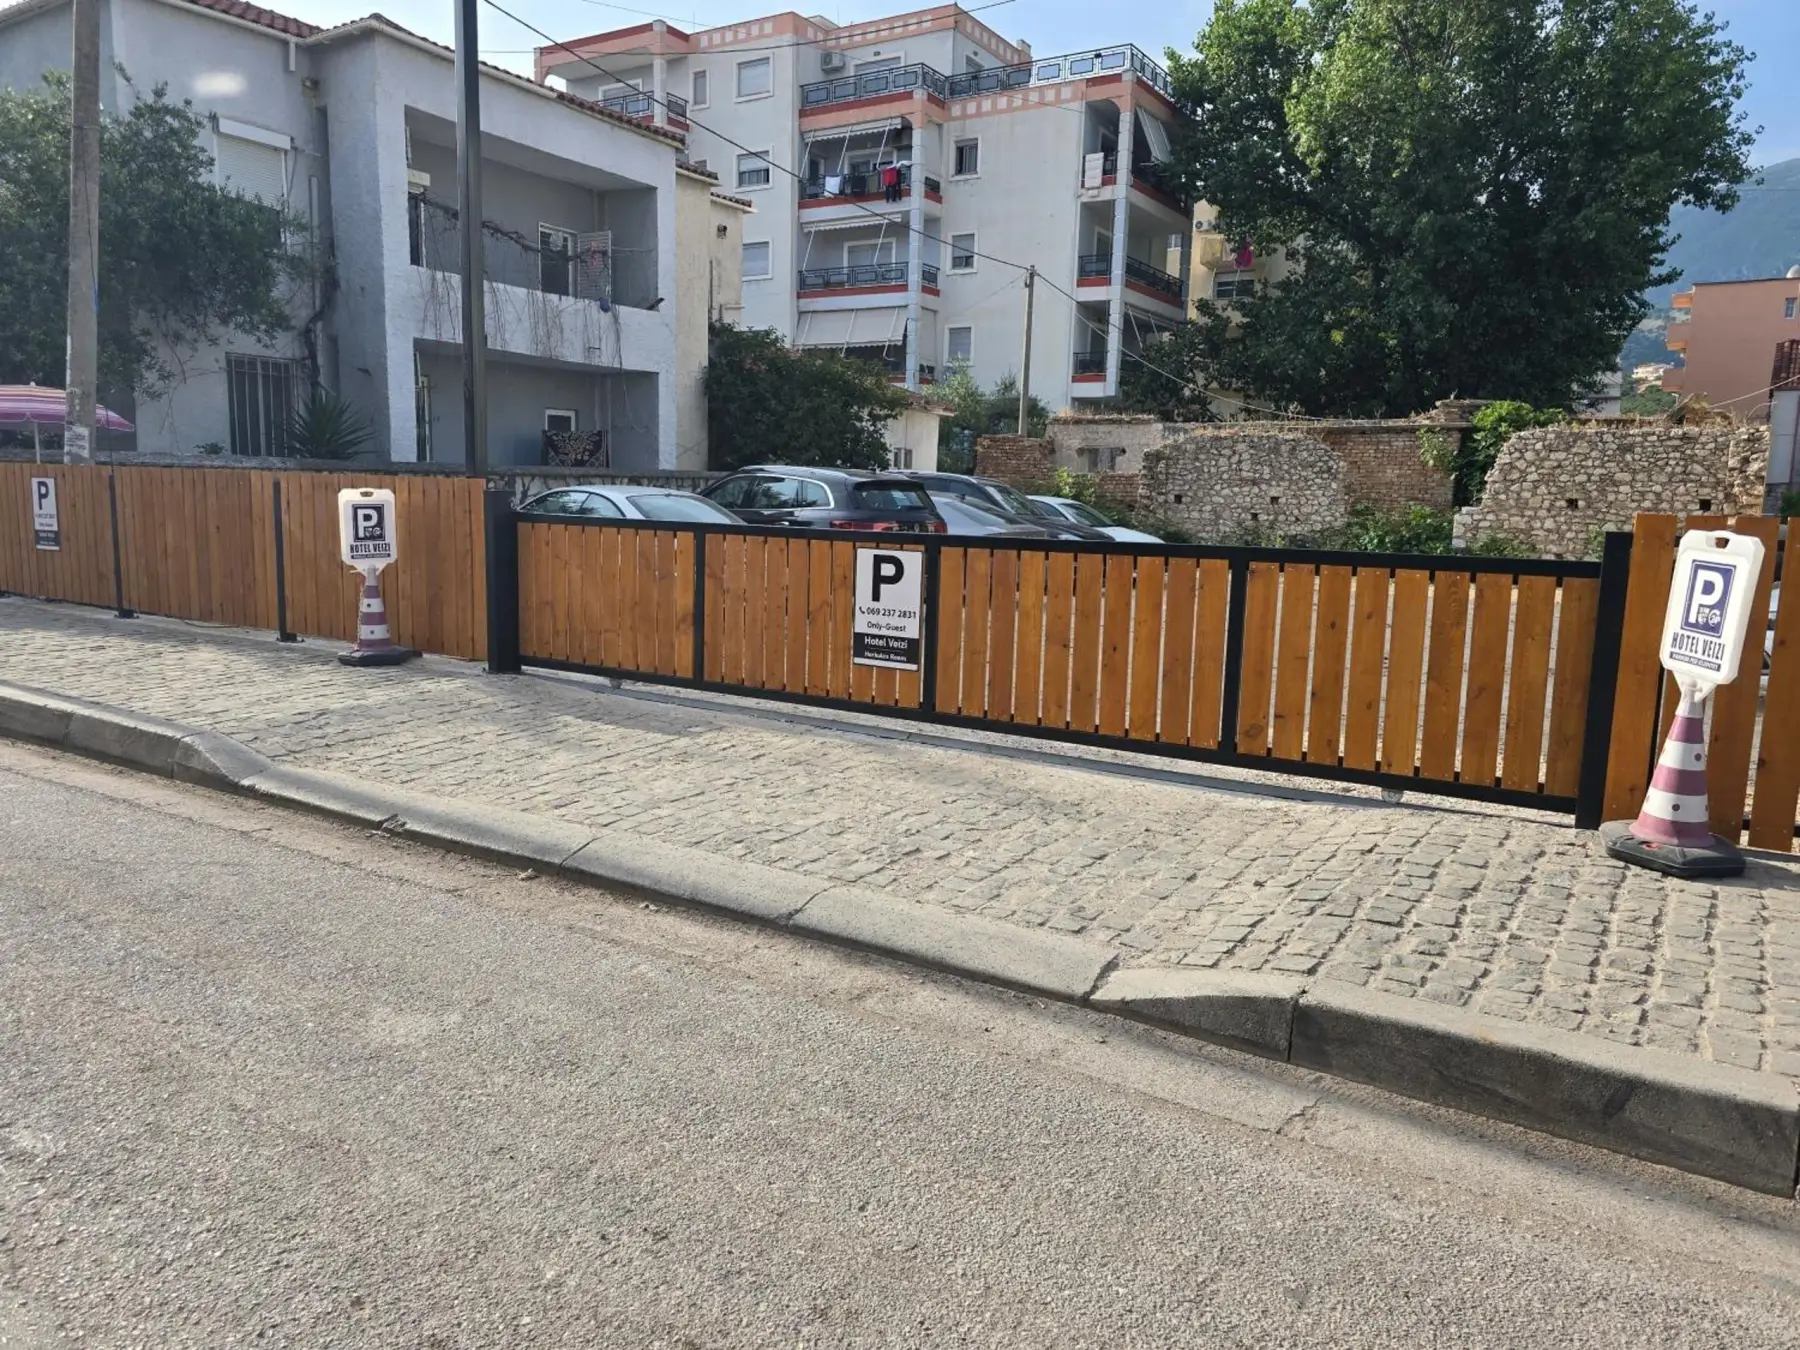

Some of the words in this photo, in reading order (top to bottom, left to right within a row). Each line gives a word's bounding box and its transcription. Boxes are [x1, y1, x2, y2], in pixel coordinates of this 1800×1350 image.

[37, 480, 49, 510] P
[357, 508, 378, 538] P
[350, 543, 371, 553] HOTEL
[372, 542, 391, 552] VEIZI
[871, 553, 904, 602] P
[1688, 569, 1724, 624] P
[866, 606, 881, 616] 069
[882, 608, 896, 617] 237
[897, 610, 917, 619] 2831
[864, 636, 887, 648] Hotel
[888, 638, 908, 650] Veizi
[1671, 631, 1699, 655] HOTEL
[1701, 638, 1726, 661] VEIZI
